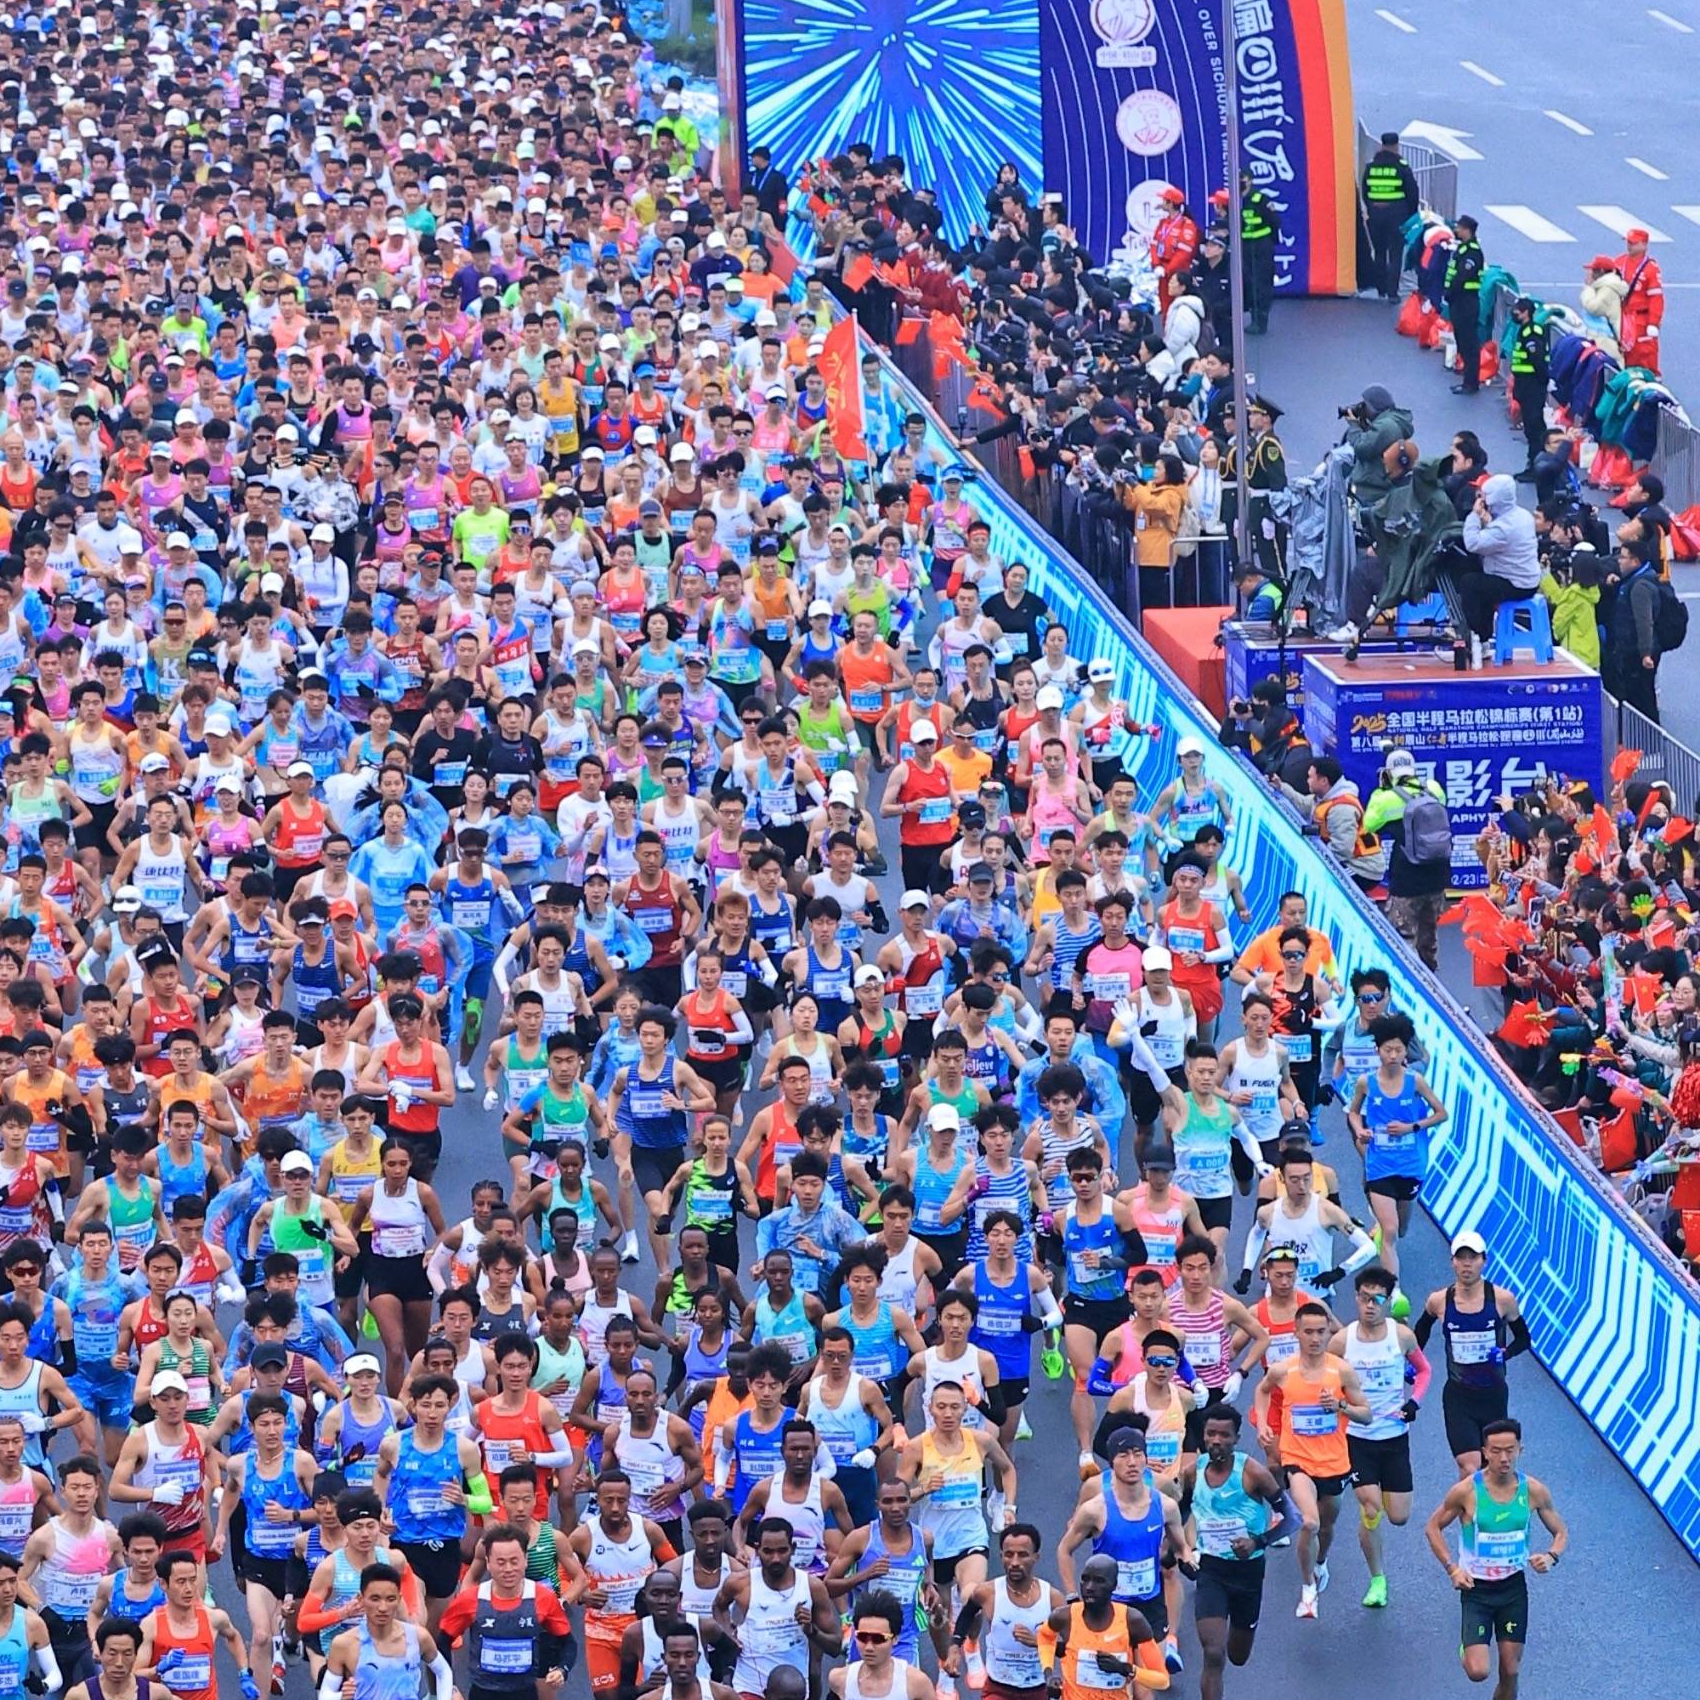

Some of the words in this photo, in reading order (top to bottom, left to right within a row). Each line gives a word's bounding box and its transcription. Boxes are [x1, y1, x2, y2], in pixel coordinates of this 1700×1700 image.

[1198, 8, 1218, 52] OVER
[1387, 705, 1584, 727] 全国半程马拉松锦标赛(第1站)
